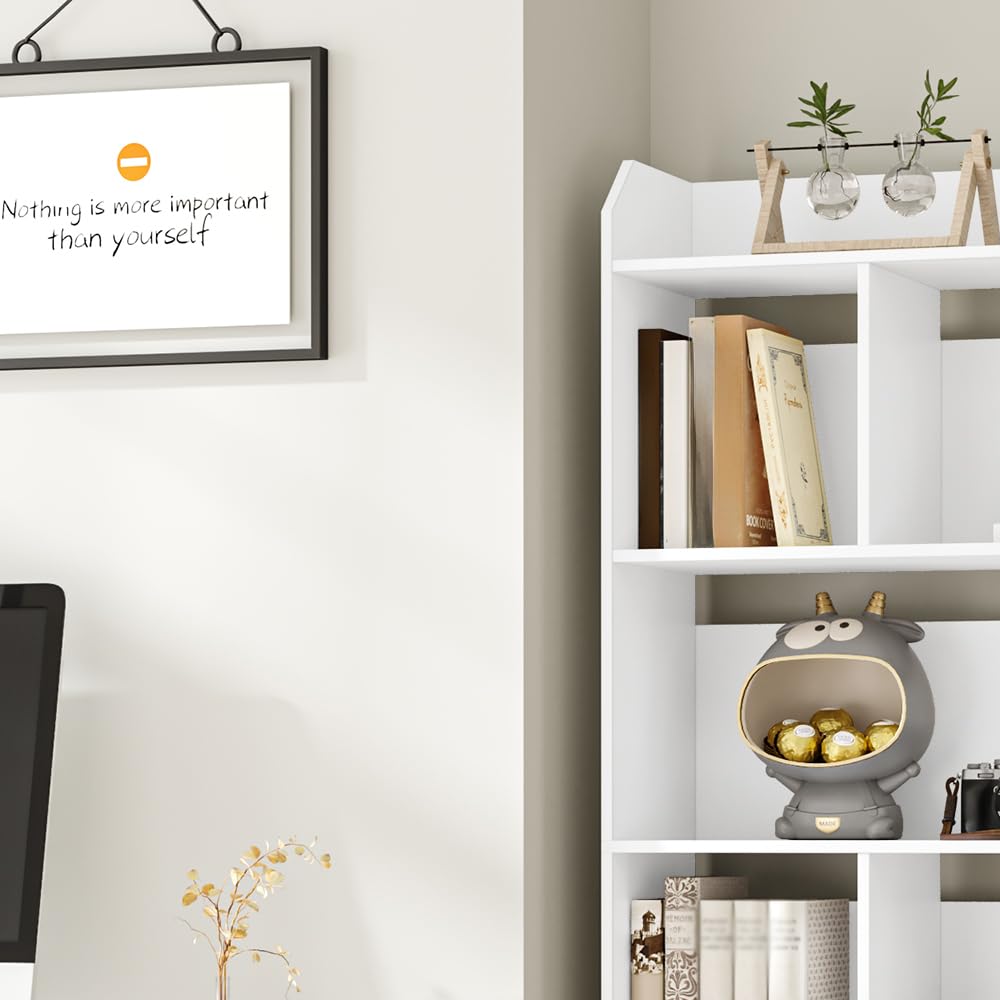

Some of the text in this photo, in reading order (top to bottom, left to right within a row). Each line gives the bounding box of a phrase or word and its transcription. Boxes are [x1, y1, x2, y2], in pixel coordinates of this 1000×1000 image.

[1, 191, 270, 226] Nothing is more important
[47, 212, 213, 257] than yourself
